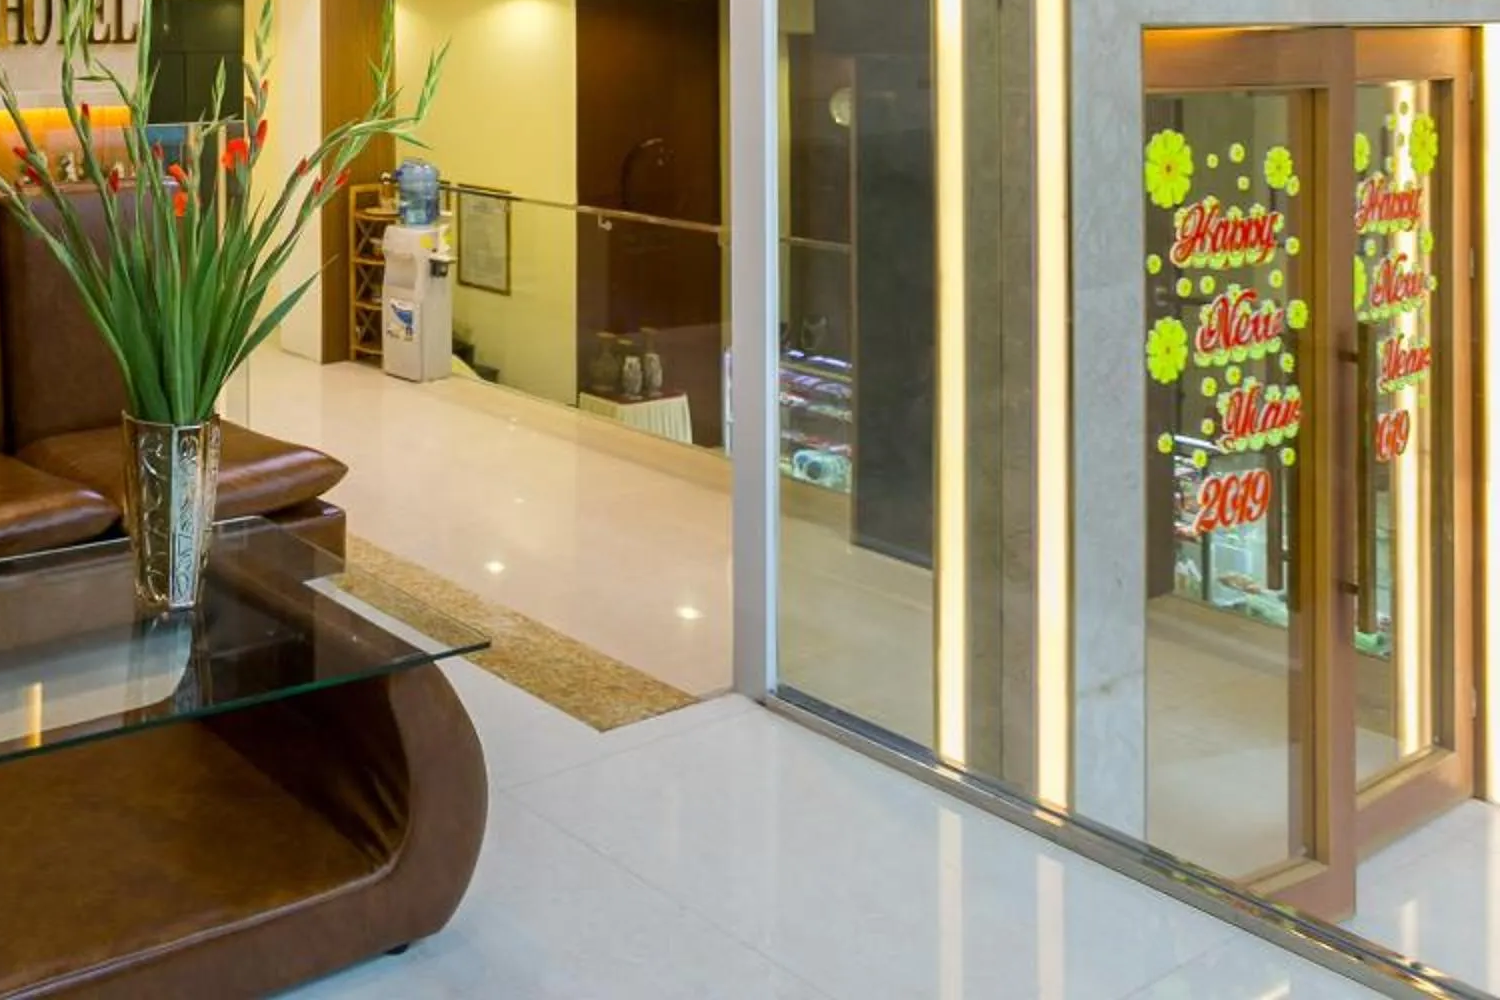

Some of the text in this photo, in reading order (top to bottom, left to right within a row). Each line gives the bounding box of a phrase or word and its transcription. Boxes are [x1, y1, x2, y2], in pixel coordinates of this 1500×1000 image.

[1170, 202, 1280, 265] Happy
[1355, 178, 1422, 232] Happy
[1370, 252, 1426, 307] New
[1196, 287, 1285, 354] New
[1374, 408, 1411, 463] 019
[1193, 469, 1273, 537] 2019
